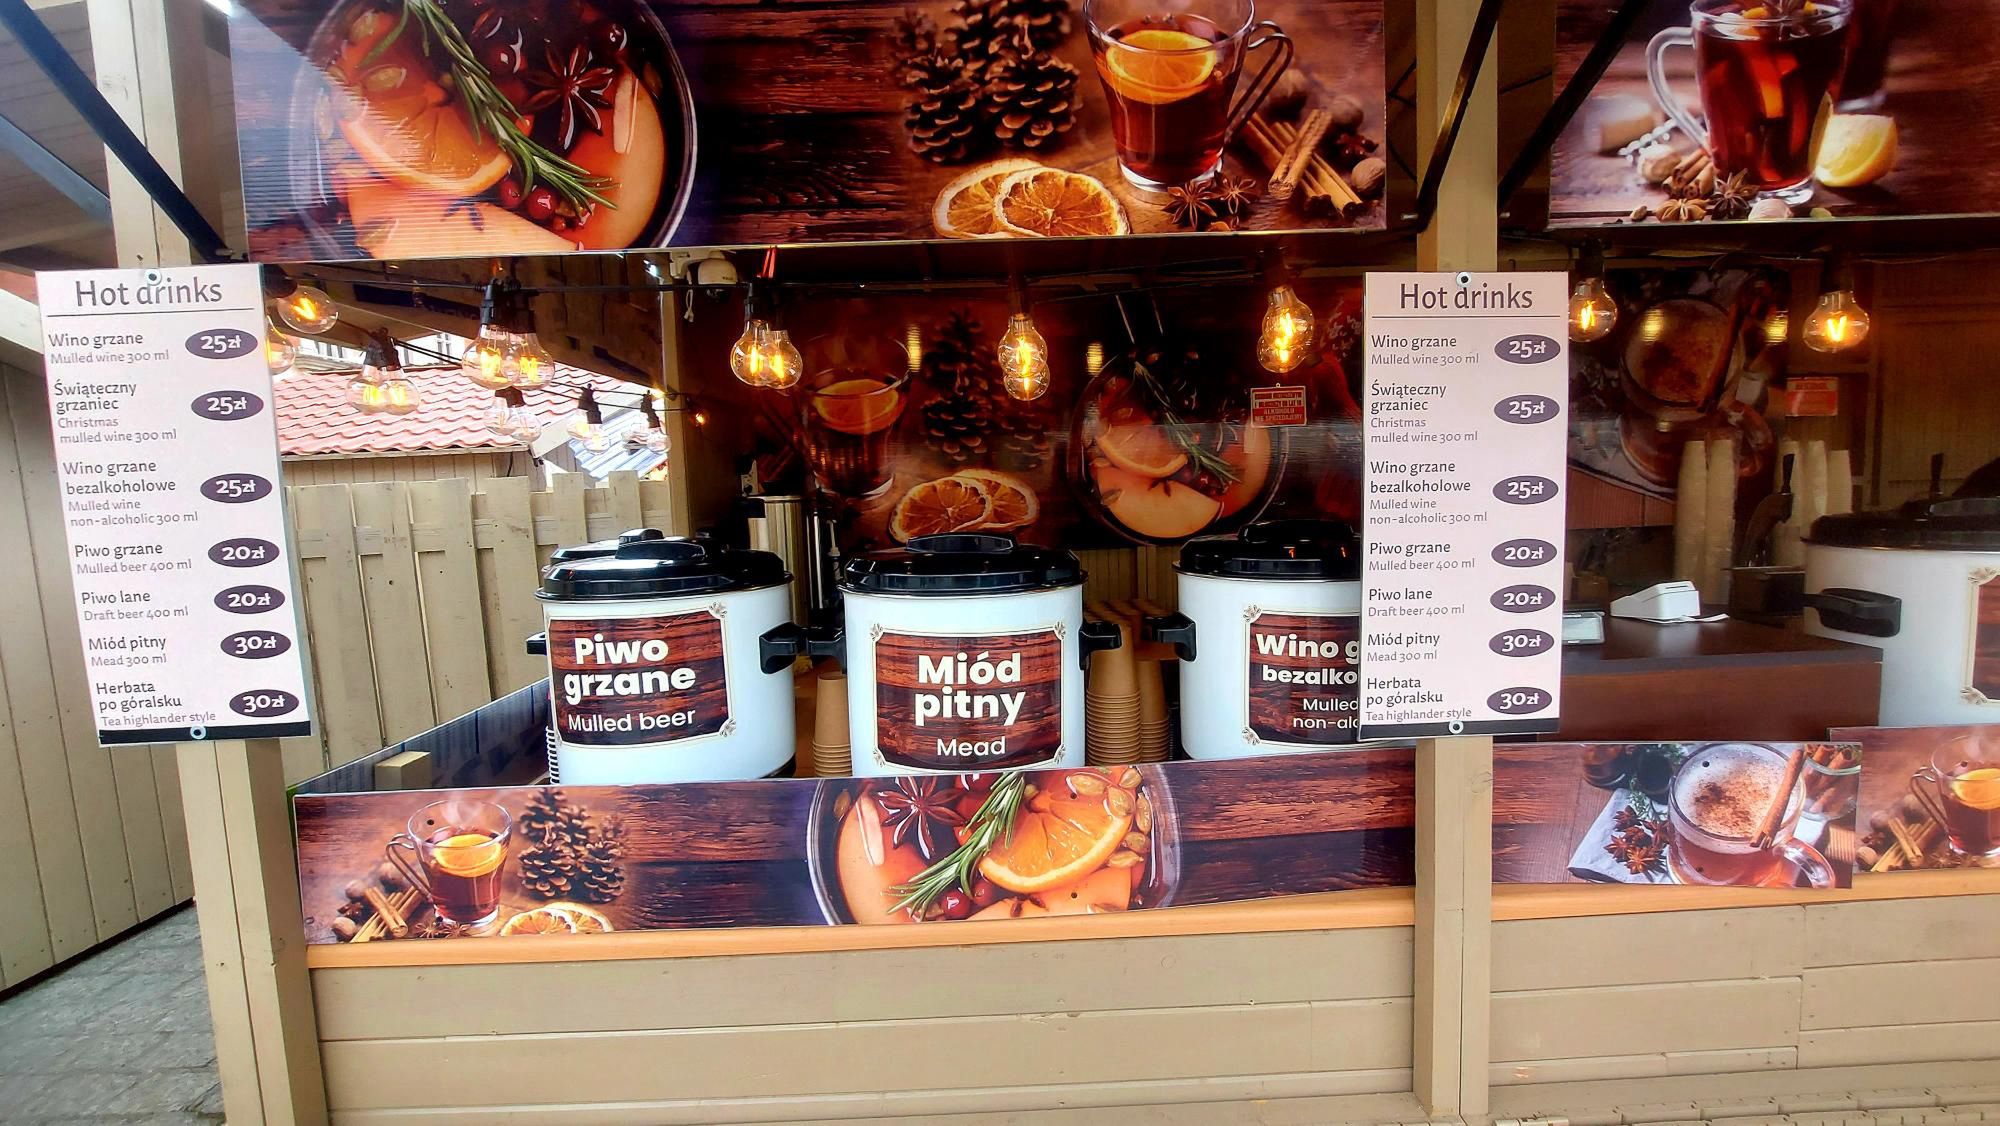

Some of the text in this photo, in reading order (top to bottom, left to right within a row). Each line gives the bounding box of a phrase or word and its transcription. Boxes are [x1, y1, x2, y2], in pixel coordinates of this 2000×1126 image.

[76, 277, 223, 306] Hot drinks
[1400, 282, 1533, 309] Hot drinks
[48, 333, 143, 348] Wino grzane
[200, 335, 242, 353] 25zł
[1371, 335, 1457, 350] Wino grzane
[1509, 340, 1546, 358] 25zł
[51, 350, 169, 364] Mulled wine 300 ml
[1371, 353, 1479, 366] Mulled wine 300 ml
[54, 379, 137, 397] Świąteczny
[1371, 379, 1446, 398] Świąteczny
[56, 398, 119, 414] grzaniec
[207, 397, 247, 414] 25zł
[1371, 398, 1429, 414] grzaniec
[1509, 401, 1545, 418] 25zł
[58, 417, 118, 428] Christmas
[1371, 417, 1426, 428] Christmas
[60, 429, 177, 443] mulled wine 300 ml
[1371, 431, 1478, 444] mulled wine 300 ml
[63, 461, 156, 477] Wino grzane
[1370, 461, 1456, 476] Wino grzane
[66, 480, 176, 495] bezalkoholowe
[216, 480, 256, 497] 25zł
[1370, 480, 1471, 493] bezalkoholowe
[1507, 481, 1544, 499] 25zł
[69, 500, 141, 512] Mulled wine
[1370, 499, 1436, 509] Mulled wine
[71, 511, 198, 527] non-alcoholic 300 ml
[1370, 512, 1488, 525] non-alcoholic 300 ml
[75, 543, 163, 559] Piwo grzane
[222, 546, 266, 560] 20zł
[1370, 542, 1451, 557] Piwo grzane
[1504, 546, 1544, 560] 20zł
[77, 559, 192, 574] Mulled beer 400 ml
[1369, 558, 1475, 571] Mulled beer 400 ml
[82, 590, 151, 605] Piwo lane
[228, 592, 271, 607] 20zł
[1369, 588, 1433, 601] Piwo lane
[1503, 592, 1543, 606] 20zł
[84, 606, 189, 621] Draft beer 400 ml
[1368, 604, 1465, 617] Draft beer 400 ml
[89, 634, 166, 651] Miód pitny
[234, 636, 277, 654] 30zł
[1256, 634, 1339, 658] Wino
[1368, 632, 1440, 647] Miód pitny
[1502, 634, 1542, 652] 30zł
[574, 633, 669, 665] Piwo
[1367, 650, 1437, 663] Mead 300 ml
[92, 653, 167, 667] Mead 300 ml
[918, 651, 1021, 685] Miód
[1262, 664, 1358, 684] bezalko
[96, 682, 155, 694] Herbata
[564, 667, 696, 705] grzane
[1367, 677, 1421, 689] Herbata
[99, 696, 182, 714] po góralsku
[243, 695, 286, 713] 30zł
[915, 686, 1026, 727] pitny
[1366, 692, 1443, 708] po góralsku
[1500, 693, 1540, 709] 30zł
[102, 710, 216, 728] Tea highlander style
[568, 710, 696, 732] Mulled beer
[1366, 708, 1472, 722] Tea highlander style
[937, 736, 1006, 757] Mead
